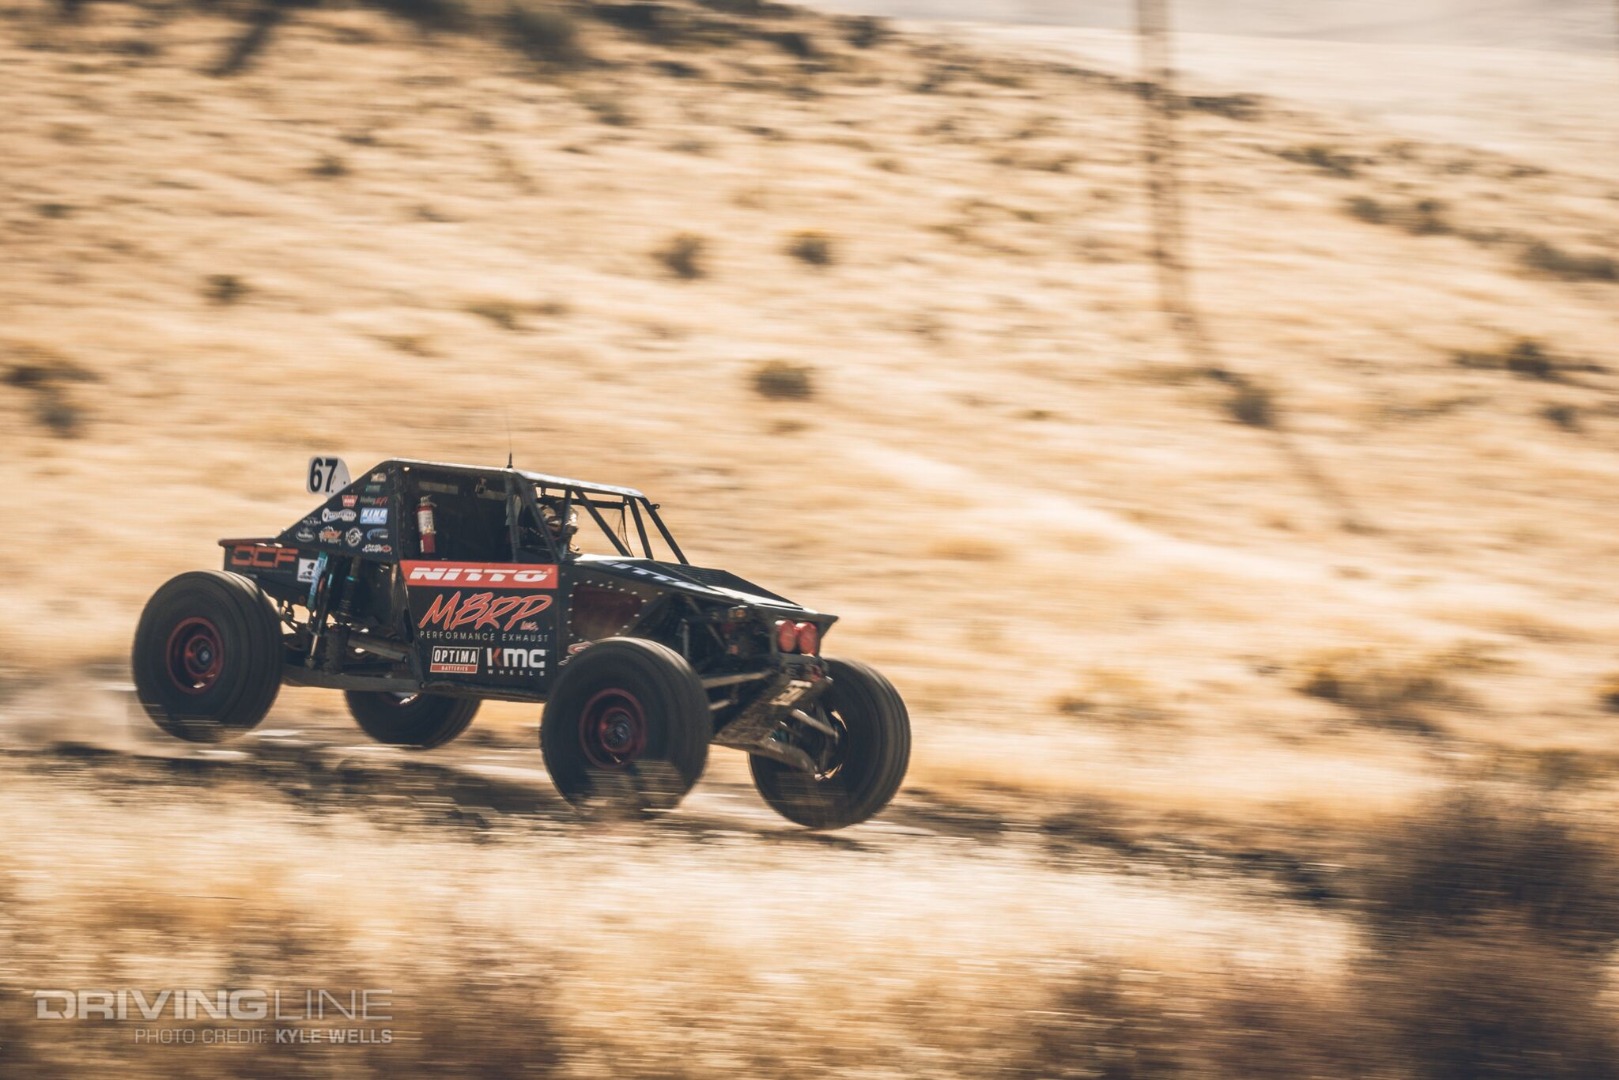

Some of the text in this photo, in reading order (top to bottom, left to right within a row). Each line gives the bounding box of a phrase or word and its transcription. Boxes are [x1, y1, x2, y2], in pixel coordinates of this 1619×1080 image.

[309, 457, 338, 493] 67
[409, 567, 549, 583] NITTO
[418, 590, 553, 632] MBRP
[420, 630, 549, 642] PERFORMANCE EXHAUST
[434, 649, 477, 663] OPTIMA
[486, 647, 546, 669] KMC
